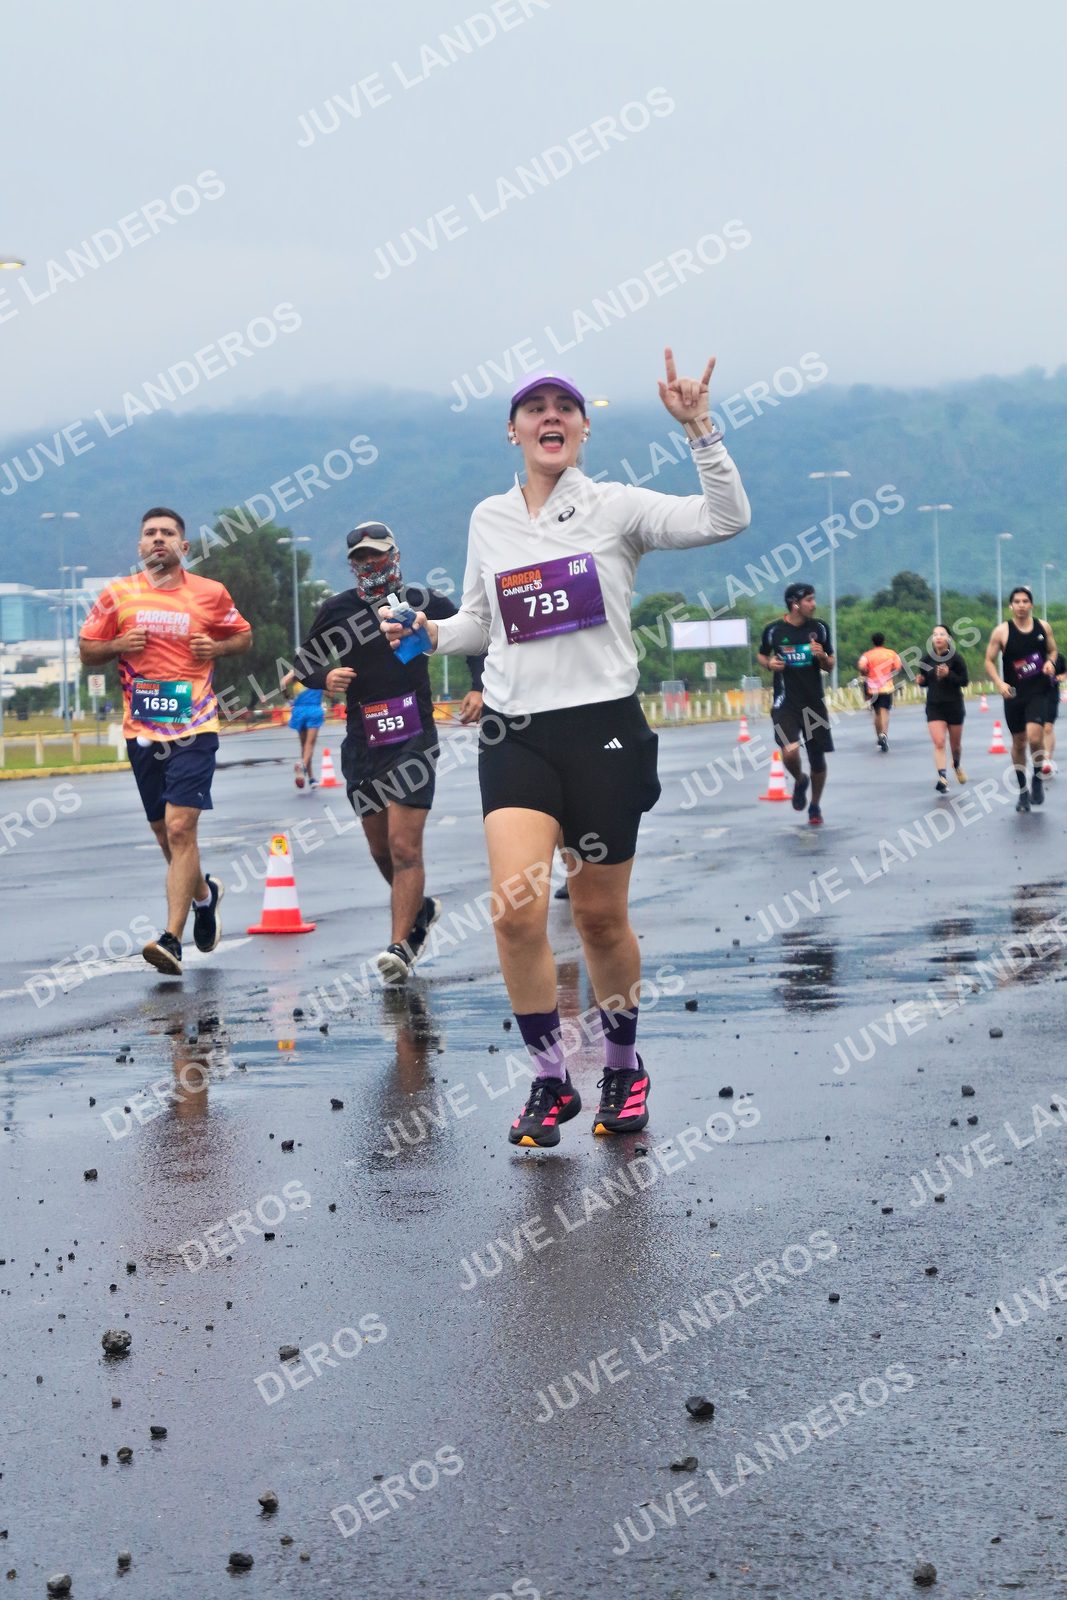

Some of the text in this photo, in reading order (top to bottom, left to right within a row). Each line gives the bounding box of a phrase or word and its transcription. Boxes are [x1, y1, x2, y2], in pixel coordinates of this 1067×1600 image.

[568, 559, 588, 576] 15K
[501, 569, 541, 588] CARRERA
[523, 590, 570, 618] 733
[135, 609, 190, 625] CARRERA
[142, 697, 179, 712] 1639
[377, 715, 405, 732] 553
